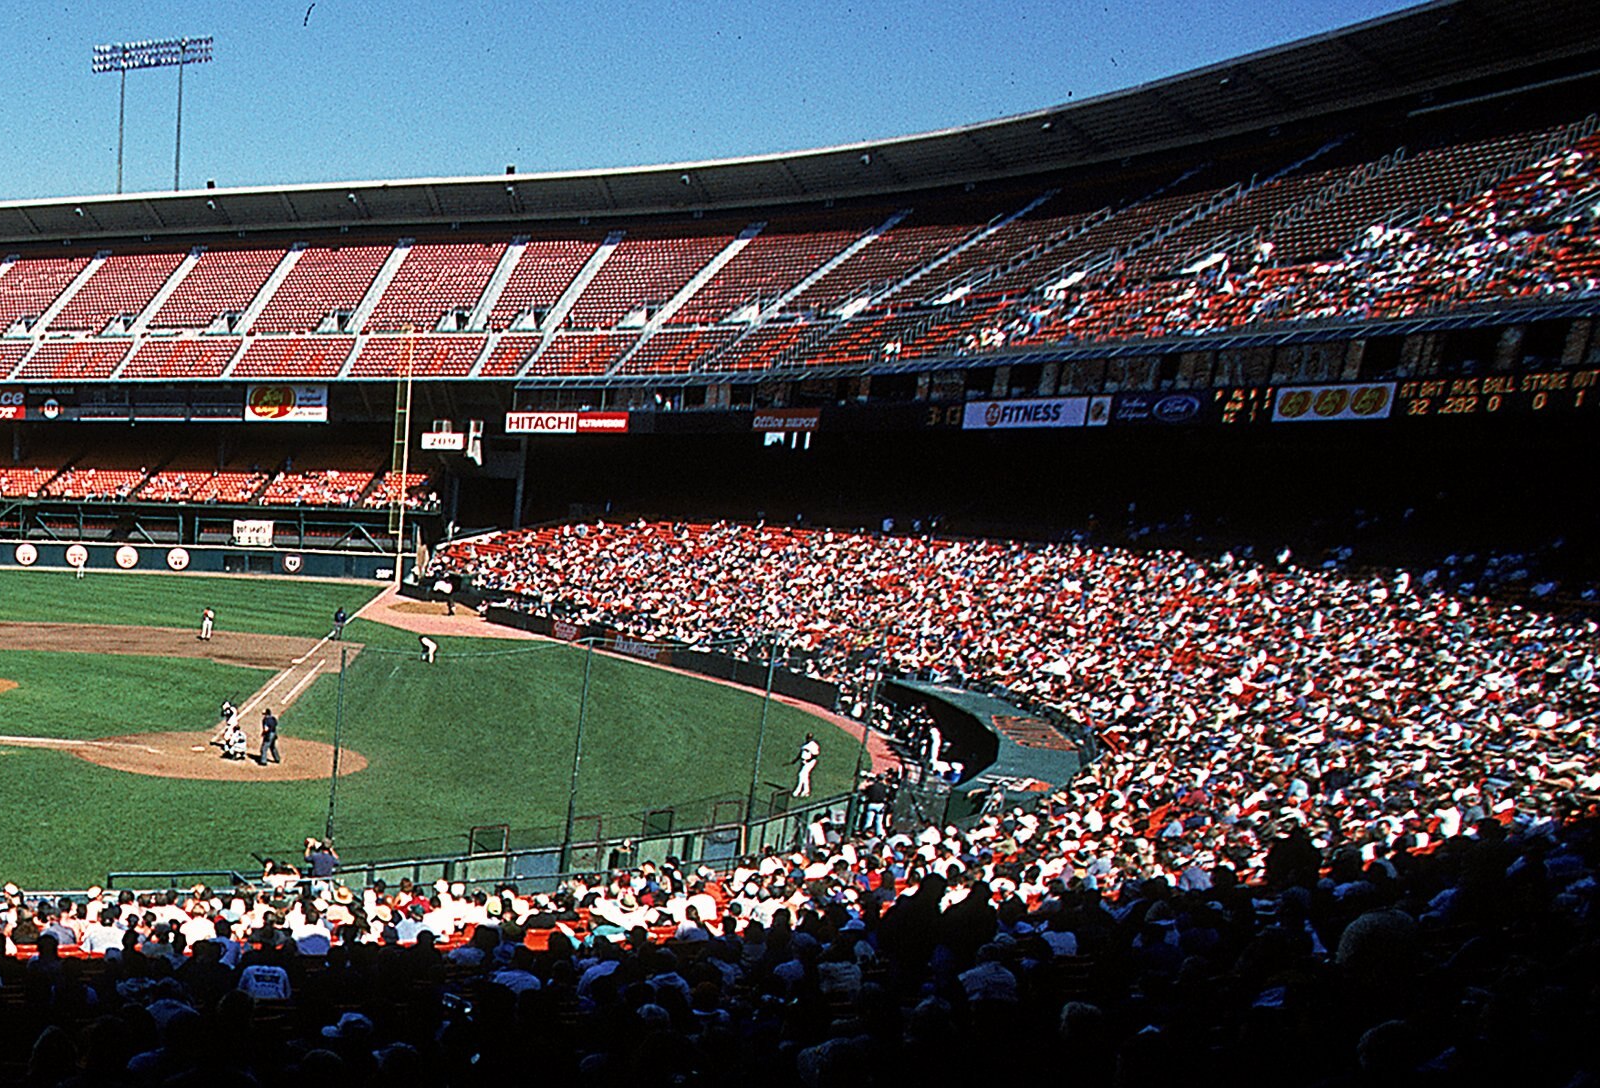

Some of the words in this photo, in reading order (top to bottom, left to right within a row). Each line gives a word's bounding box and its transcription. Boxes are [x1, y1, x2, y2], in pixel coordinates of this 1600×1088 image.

[1481, 375, 1516, 394] BALL
[1407, 398, 1431, 415] 32
[1486, 393, 1502, 412] 0
[1532, 391, 1548, 410] 0
[508, 416, 575, 430] HITACHI
[1000, 404, 1063, 423] FITNESS
[614, 634, 659, 660] Budweiser
